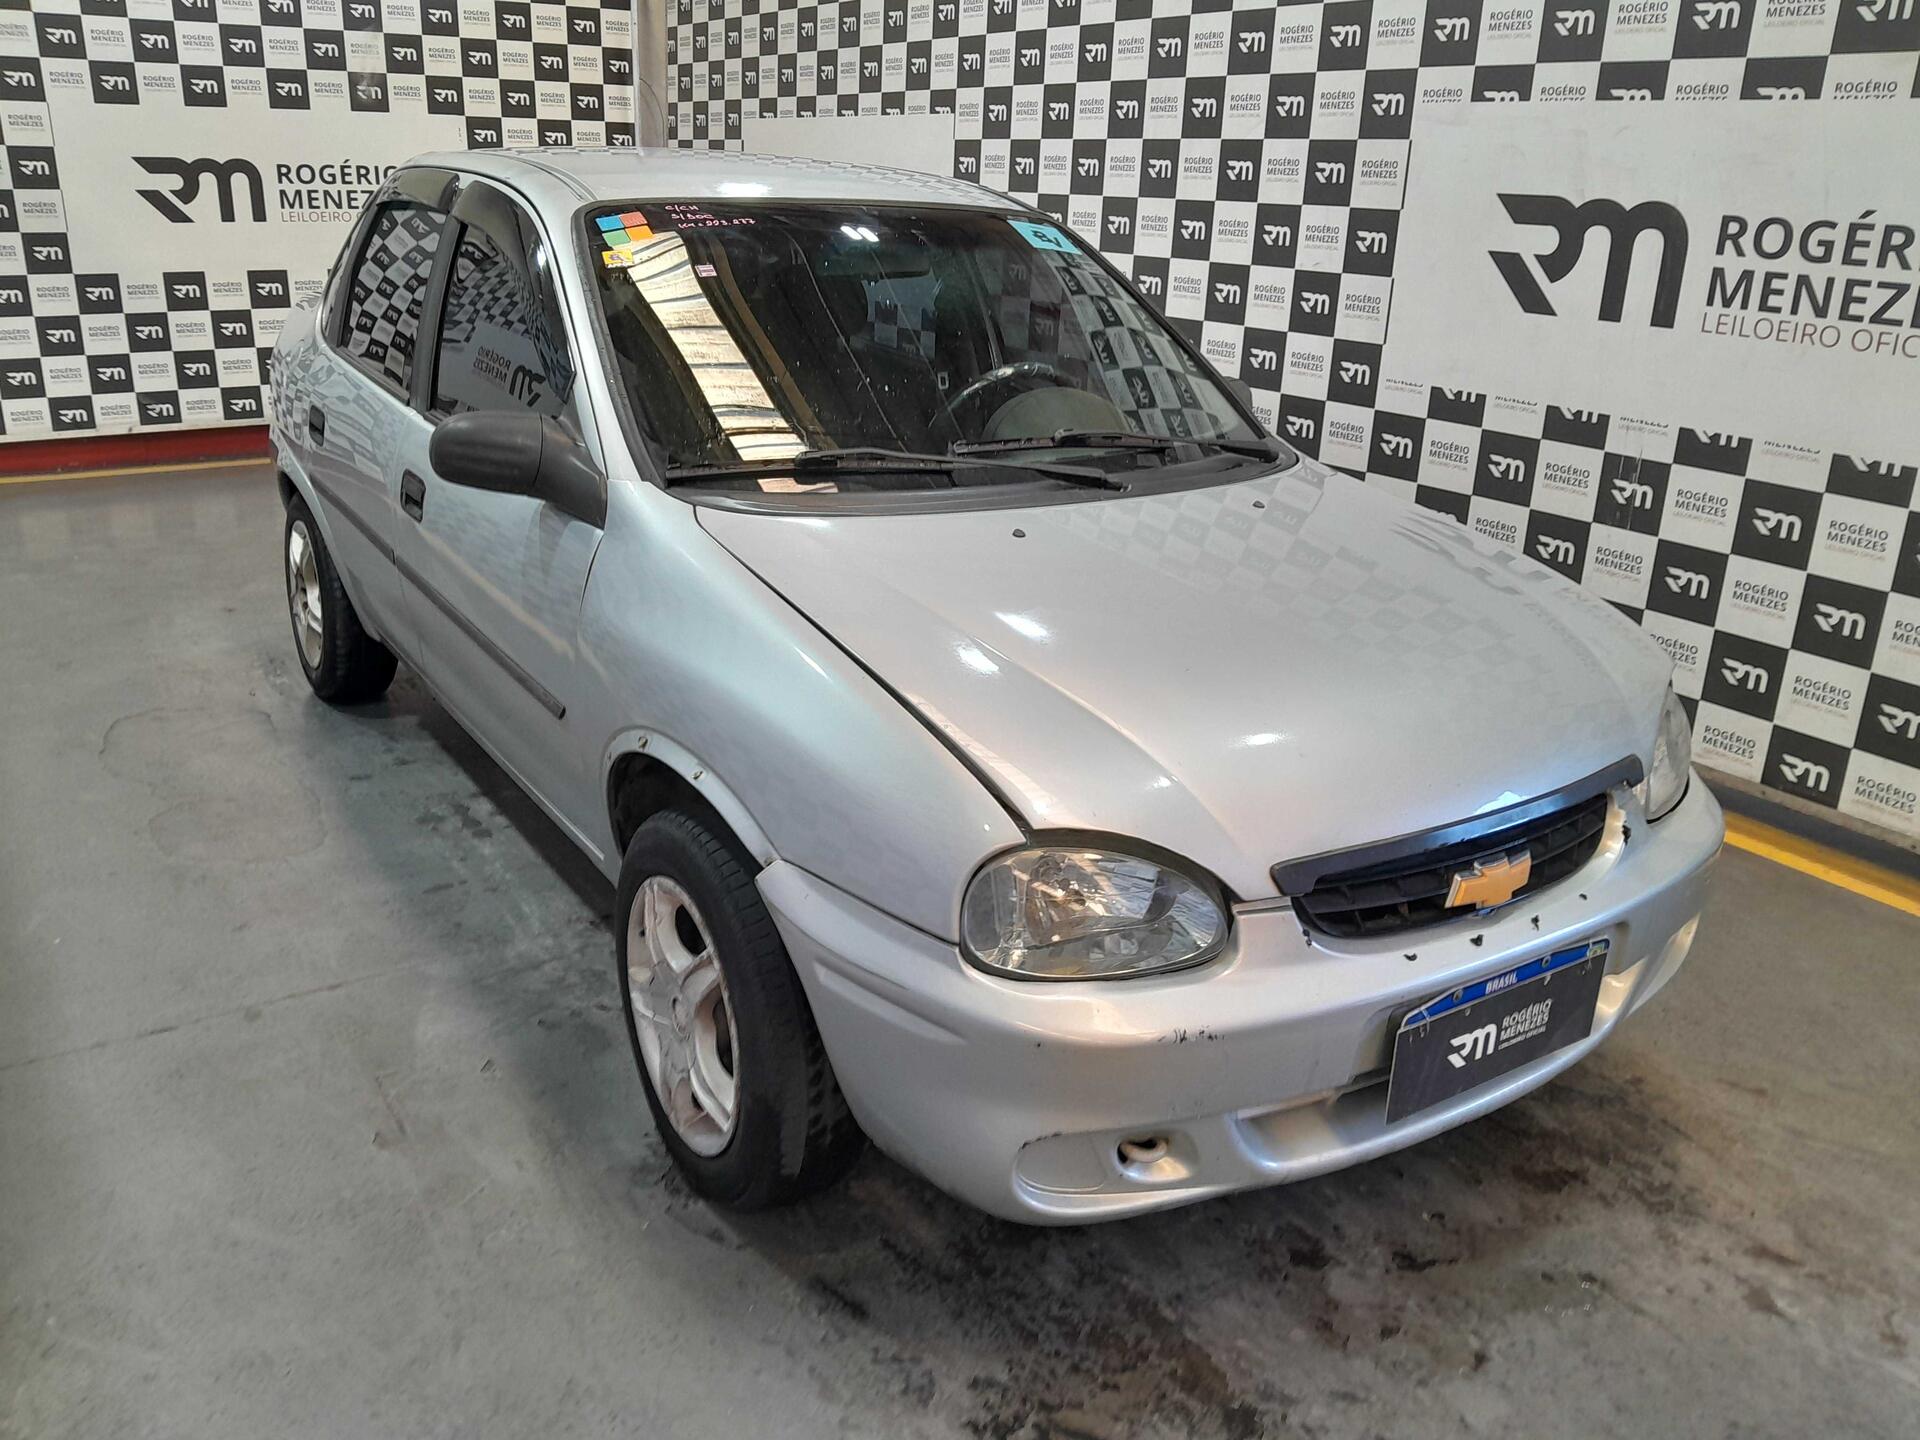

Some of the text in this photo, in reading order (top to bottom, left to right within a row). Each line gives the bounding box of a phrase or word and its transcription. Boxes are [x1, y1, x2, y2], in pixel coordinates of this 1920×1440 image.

[1618, 0, 1668, 13] ROGÉRIO
[1766, 4, 1826, 17] MENEZES
[1490, 10, 1533, 20] ROGÉRIO
[1617, 13, 1666, 24] MENEZES
[1378, 17, 1416, 28] ROGÉRIO
[1488, 20, 1532, 31] MENEZES
[1281, 25, 1314, 34] ROGÉRIO
[1377, 28, 1415, 38] MENEZES
[1195, 31, 1224, 40] ROGÉRIO
[1280, 34, 1313, 44] MENEZES
[1194, 40, 1223, 49] MENEZES
[1541, 86, 1586, 96] ROGÉRIO
[1676, 84, 1729, 95] ROGÉRIO
[1835, 81, 1897, 93] ROGÉRIO
[1231, 94, 1261, 102] ROGÉRIO
[1321, 91, 1355, 100] ROGÉRIO
[1423, 88, 1462, 98] ROGÉRIO
[1230, 103, 1260, 111] MENEZES
[1320, 101, 1354, 109] MENEZES
[1184, 156, 1213, 165] ROGÉRIO
[1268, 158, 1300, 167] ROGÉRIO
[1362, 160, 1398, 169] ROGÉRIO
[1184, 166, 1212, 174] MENEZES
[1267, 168, 1299, 176] MENEZES
[1361, 170, 1397, 179] MENEZES
[279, 189, 375, 209] MENEZ
[281, 211, 352, 223] LEILOEIRO
[1219, 220, 1248, 228] ROGÉRIO
[1306, 225, 1339, 234] ROGÉRIO
[1218, 228, 1248, 237] MENEZES
[1305, 234, 1339, 244] MENEZES
[1715, 209, 1920, 271] ROGÉR
[1174, 276, 1201, 286] ROGÉRIO
[1173, 285, 1200, 294] MENEZES
[1254, 284, 1286, 294] ROGÉRIO
[1254, 293, 1284, 303] MENEZES
[1346, 294, 1381, 305] ROGÉRIO
[1706, 266, 1920, 329] MENEZ
[1345, 303, 1380, 314] MENEZES
[1701, 312, 1920, 358] LEILOEIRO OFIC
[1208, 340, 1236, 350] ROGÉRIO
[1207, 348, 1235, 358] MENEZES
[1292, 352, 1324, 363] ROGÉRIO
[1290, 360, 1323, 372] MENEZES
[1330, 421, 1364, 434] ROGÉRIO
[1329, 430, 1363, 443] MENEZES
[1431, 440, 1469, 454] ROGÉRIO
[1429, 449, 1468, 464] MENEZES
[1546, 462, 1590, 478] ROGÉRIO
[1544, 472, 1588, 488] MENEZES
[1677, 489, 1728, 507] ROGÉRIO
[1675, 500, 1726, 518] MENEZES
[1476, 518, 1517, 534] ROGÉRIO
[1830, 520, 1888, 540] ROGÉRIO
[1827, 531, 1886, 552] MENEZES
[1596, 546, 1643, 564] ROGÉRIO
[1595, 556, 1641, 575] MENEZES
[1735, 580, 1788, 600] ROGÉRIO
[1732, 591, 1786, 612] MENEZES
[1794, 676, 1851, 699] ROGÉRIO
[1792, 686, 1849, 710] MENEZES
[1704, 725, 1756, 748] ROGÉRIO
[1702, 735, 1753, 759] MENEZES
[1857, 776, 1916, 802] ROGÉRIO
[1855, 786, 1914, 814] MENEZES
[1486, 972, 1518, 994] BRASIL
[1502, 998, 1552, 1028] ROGÉRIO
[1500, 1013, 1550, 1041] MENEZES
